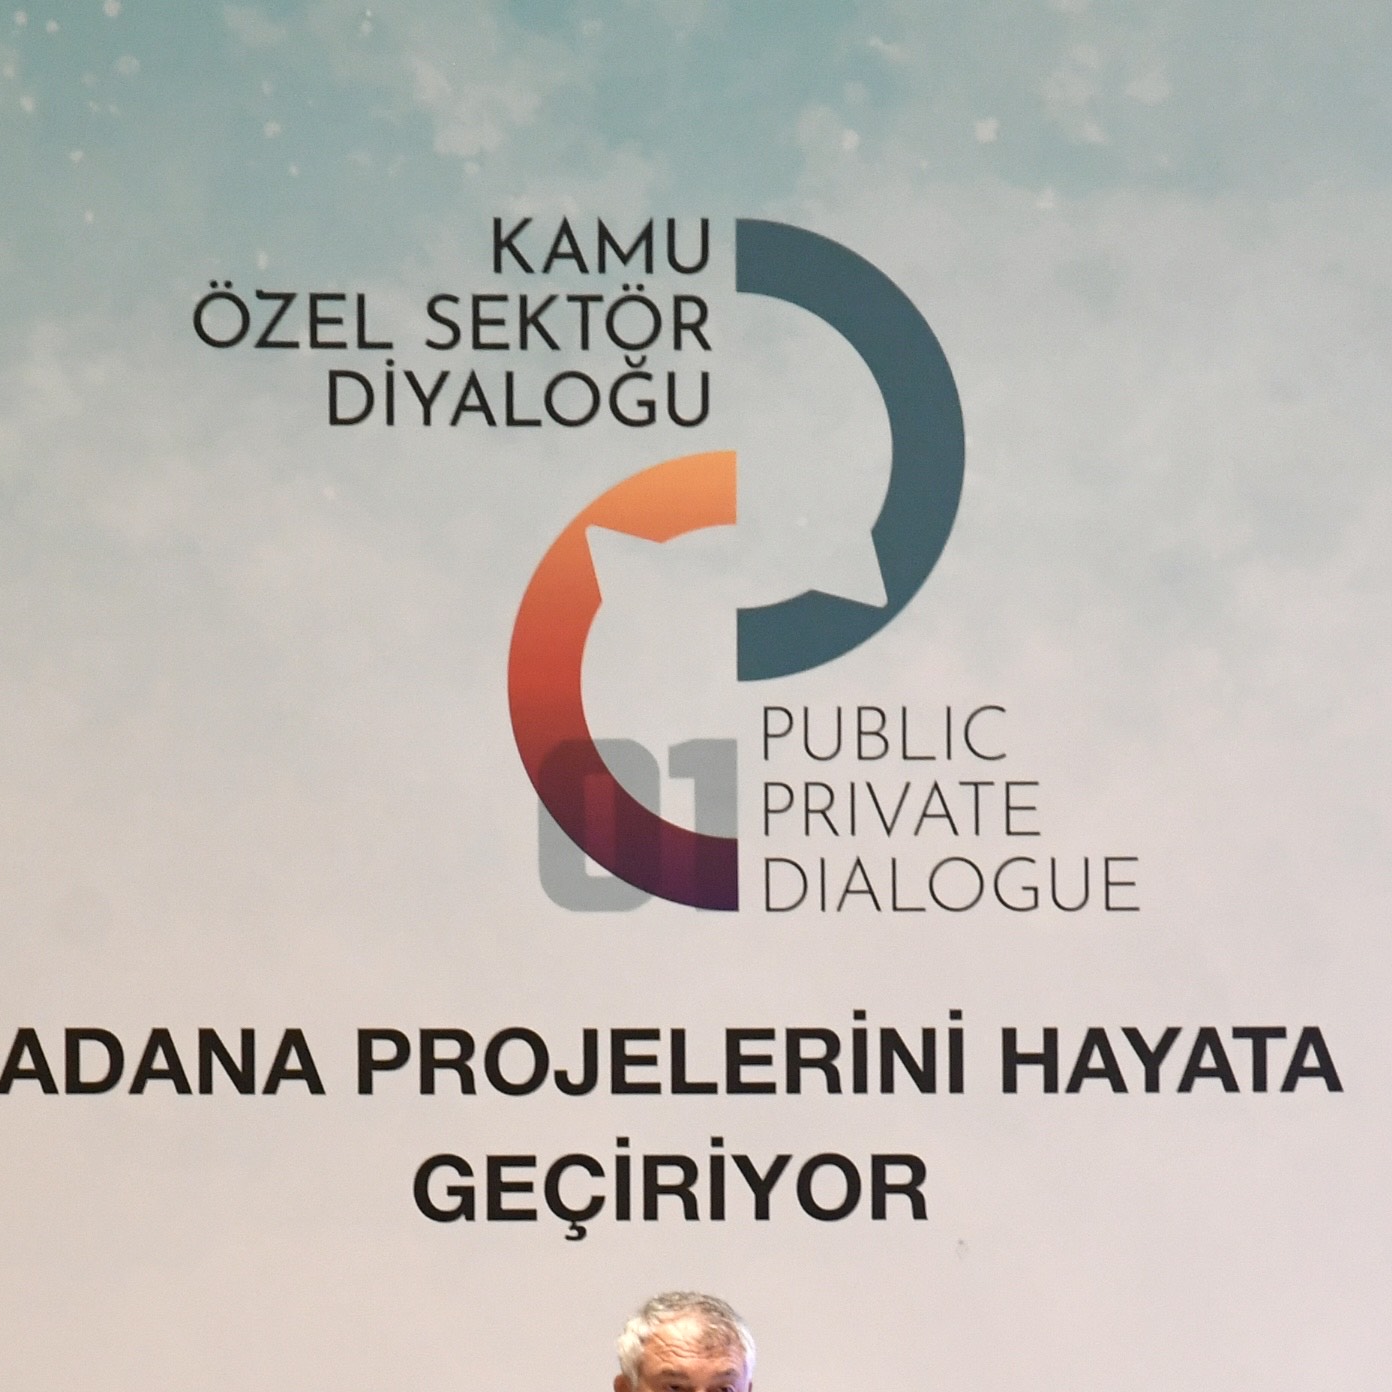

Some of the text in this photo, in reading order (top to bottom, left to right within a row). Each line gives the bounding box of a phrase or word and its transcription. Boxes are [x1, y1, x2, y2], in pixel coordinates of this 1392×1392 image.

[493, 216, 710, 275] KAMU
[192, 280, 712, 352] ÖZEL SEKTÖR
[328, 356, 710, 428] DİYALOĞU
[763, 705, 1007, 762] PUBLIC
[763, 780, 1041, 837] PRIVATE
[764, 856, 1140, 913] DIALOGUE
[357, 1009, 965, 1097] PROJELERİNİ
[1001, 1026, 1344, 1094] HAYATA
[413, 1136, 928, 1242] GEÇİRİYOR
